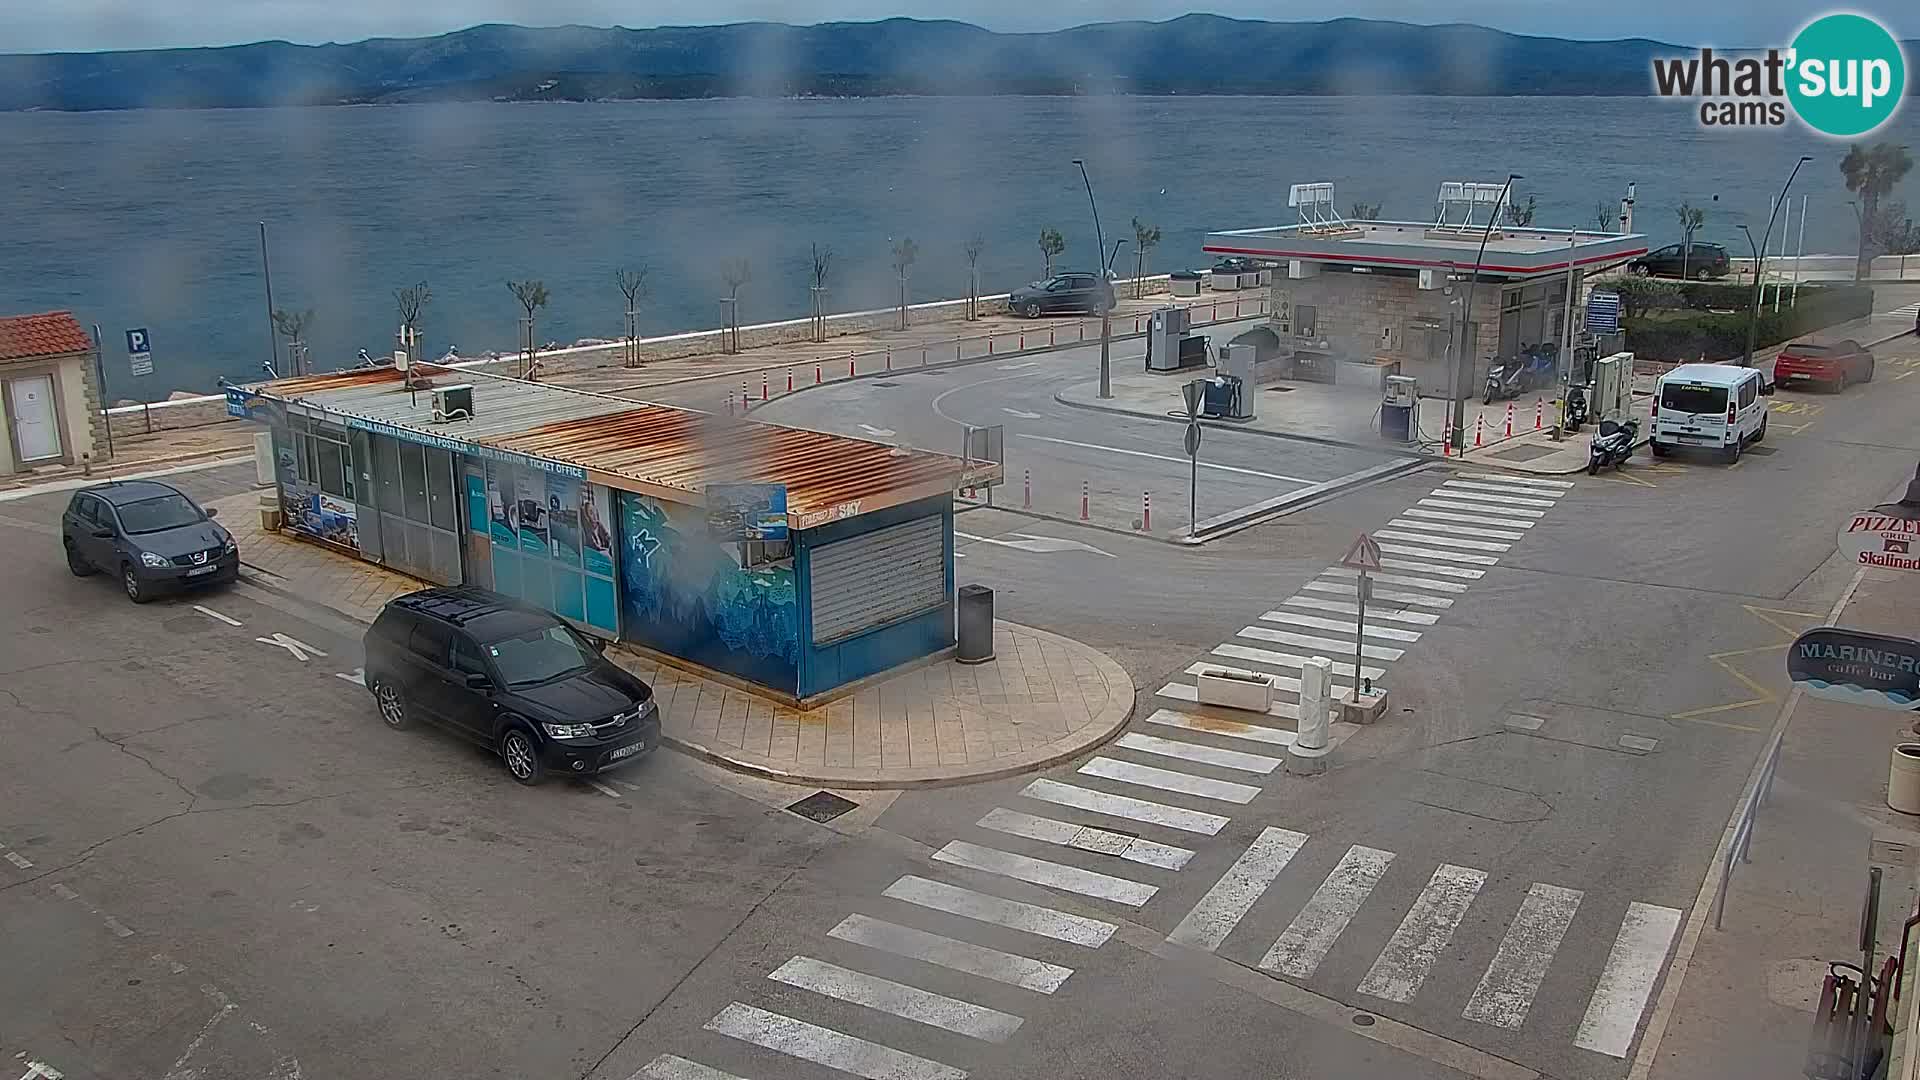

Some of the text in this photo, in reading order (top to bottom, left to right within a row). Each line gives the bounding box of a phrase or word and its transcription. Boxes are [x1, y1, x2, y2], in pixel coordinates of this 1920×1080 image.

[131, 332, 144, 350] P
[397, 428, 437, 446] AUTOBUSNA
[438, 438, 468, 452] POSTAJA
[479, 447, 495, 458] BUS
[495, 450, 527, 465] STATION
[530, 459, 555, 473] TICKET
[556, 464, 583, 478] OFFICE
[1880, 532, 1916, 542] GRILL
[1827, 663, 1896, 681] caffe bar
